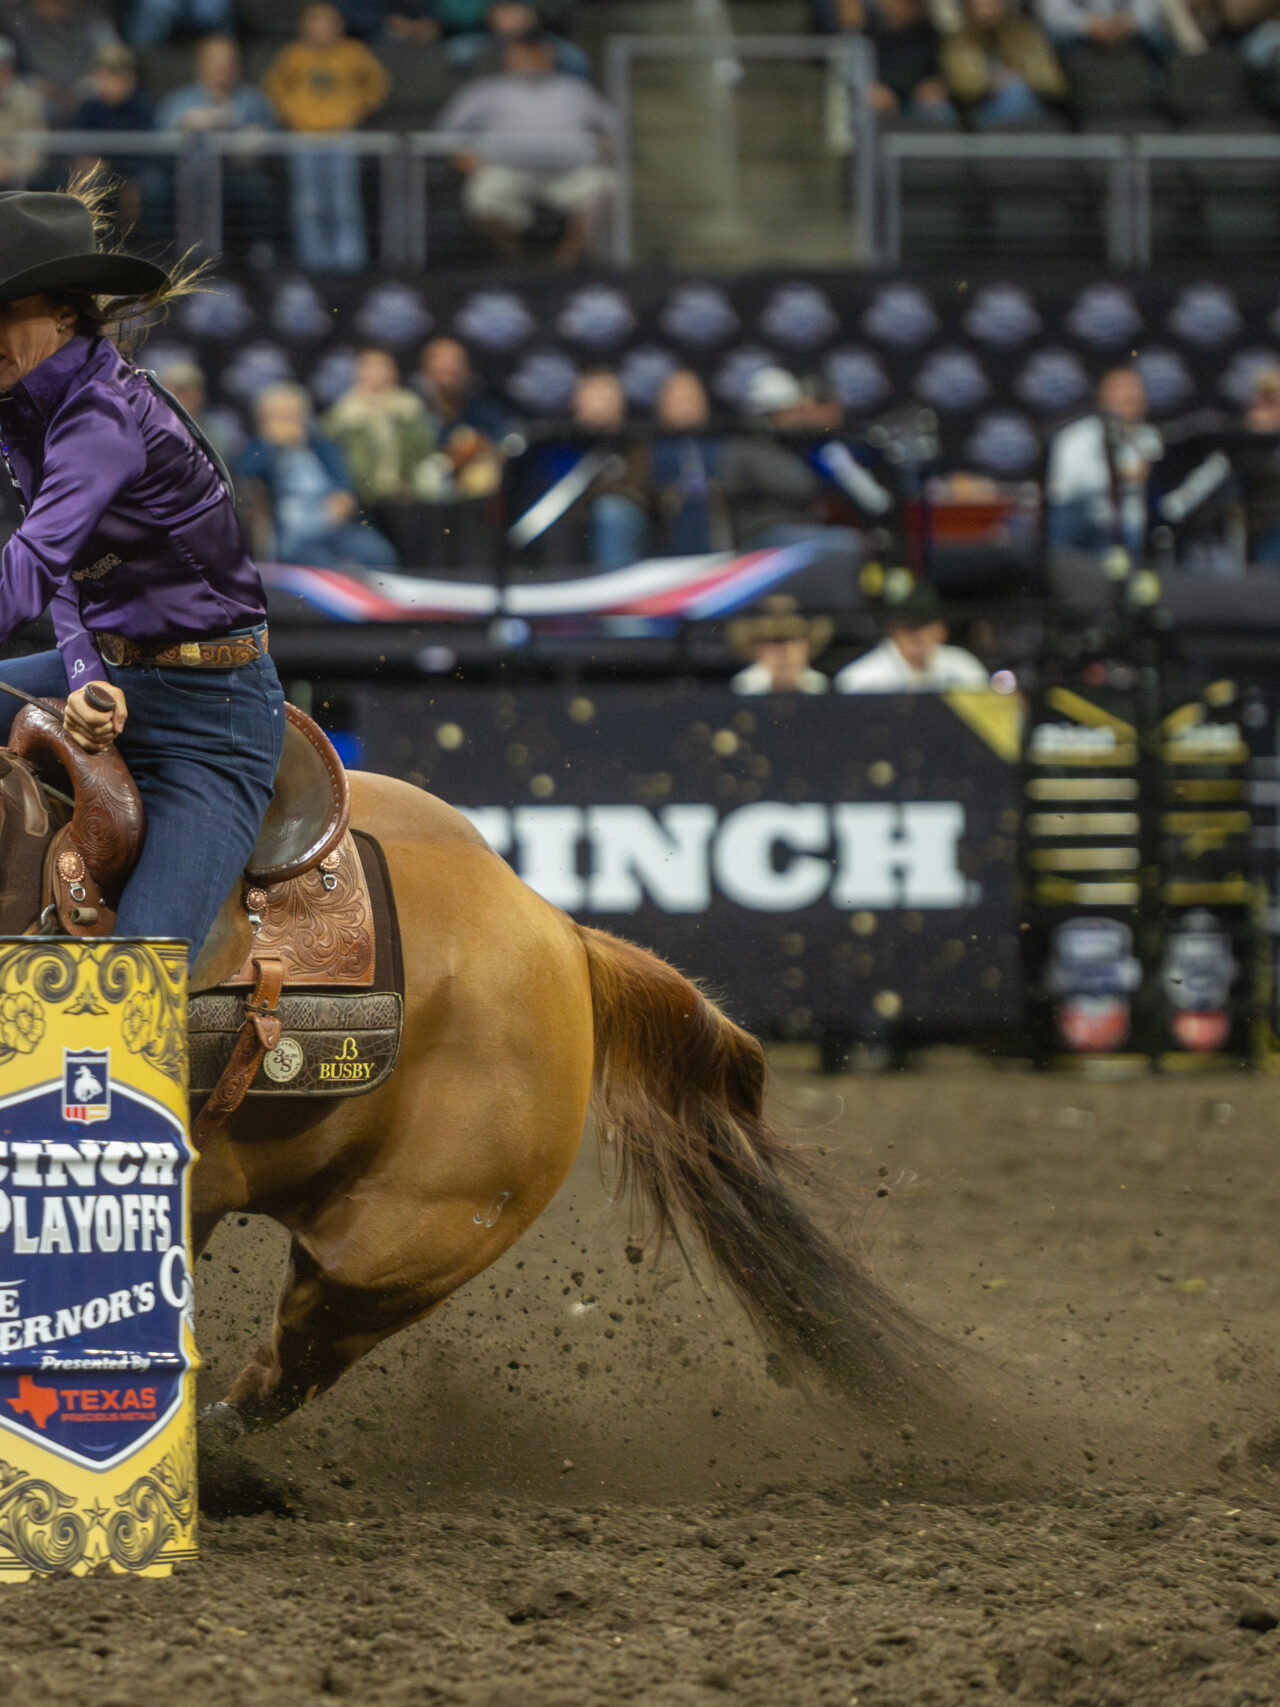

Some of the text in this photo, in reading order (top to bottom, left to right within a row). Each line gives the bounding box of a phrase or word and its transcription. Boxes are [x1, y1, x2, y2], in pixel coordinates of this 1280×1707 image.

[320, 1062, 375, 1080] BUSBY
[40, 1355, 152, 1372] Presented By
[60, 1387, 157, 1411] TEXAS
